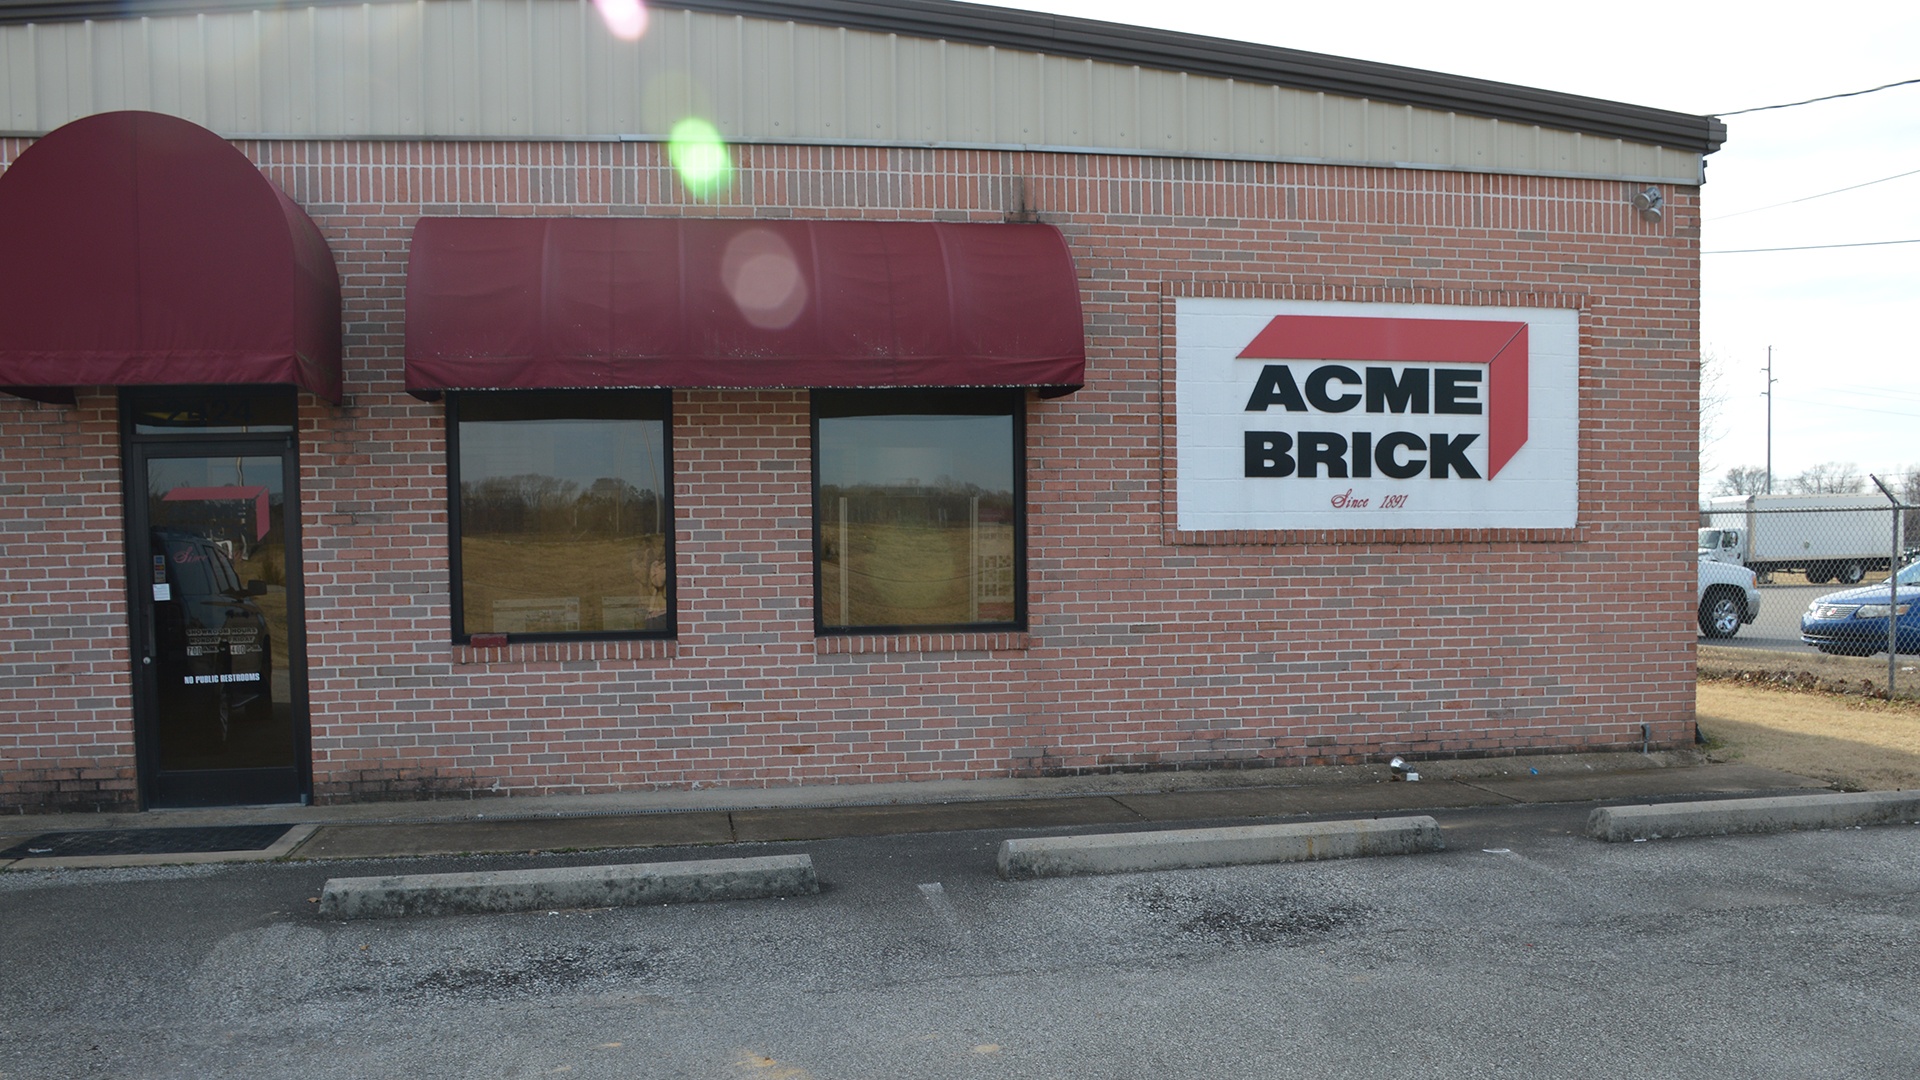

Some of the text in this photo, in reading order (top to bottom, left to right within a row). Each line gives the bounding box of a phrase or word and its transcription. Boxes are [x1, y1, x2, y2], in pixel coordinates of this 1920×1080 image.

[1244, 364, 1483, 415] ACME
[1244, 430, 1482, 479] BRICK
[1331, 488, 1369, 508] Since
[186, 627, 258, 637] SHOWROOM HOURS
[189, 637, 221, 645] MONDAY
[228, 636, 256, 644] FRIDAY
[184, 672, 261, 685] NO PUBLIC RESTROOMS
